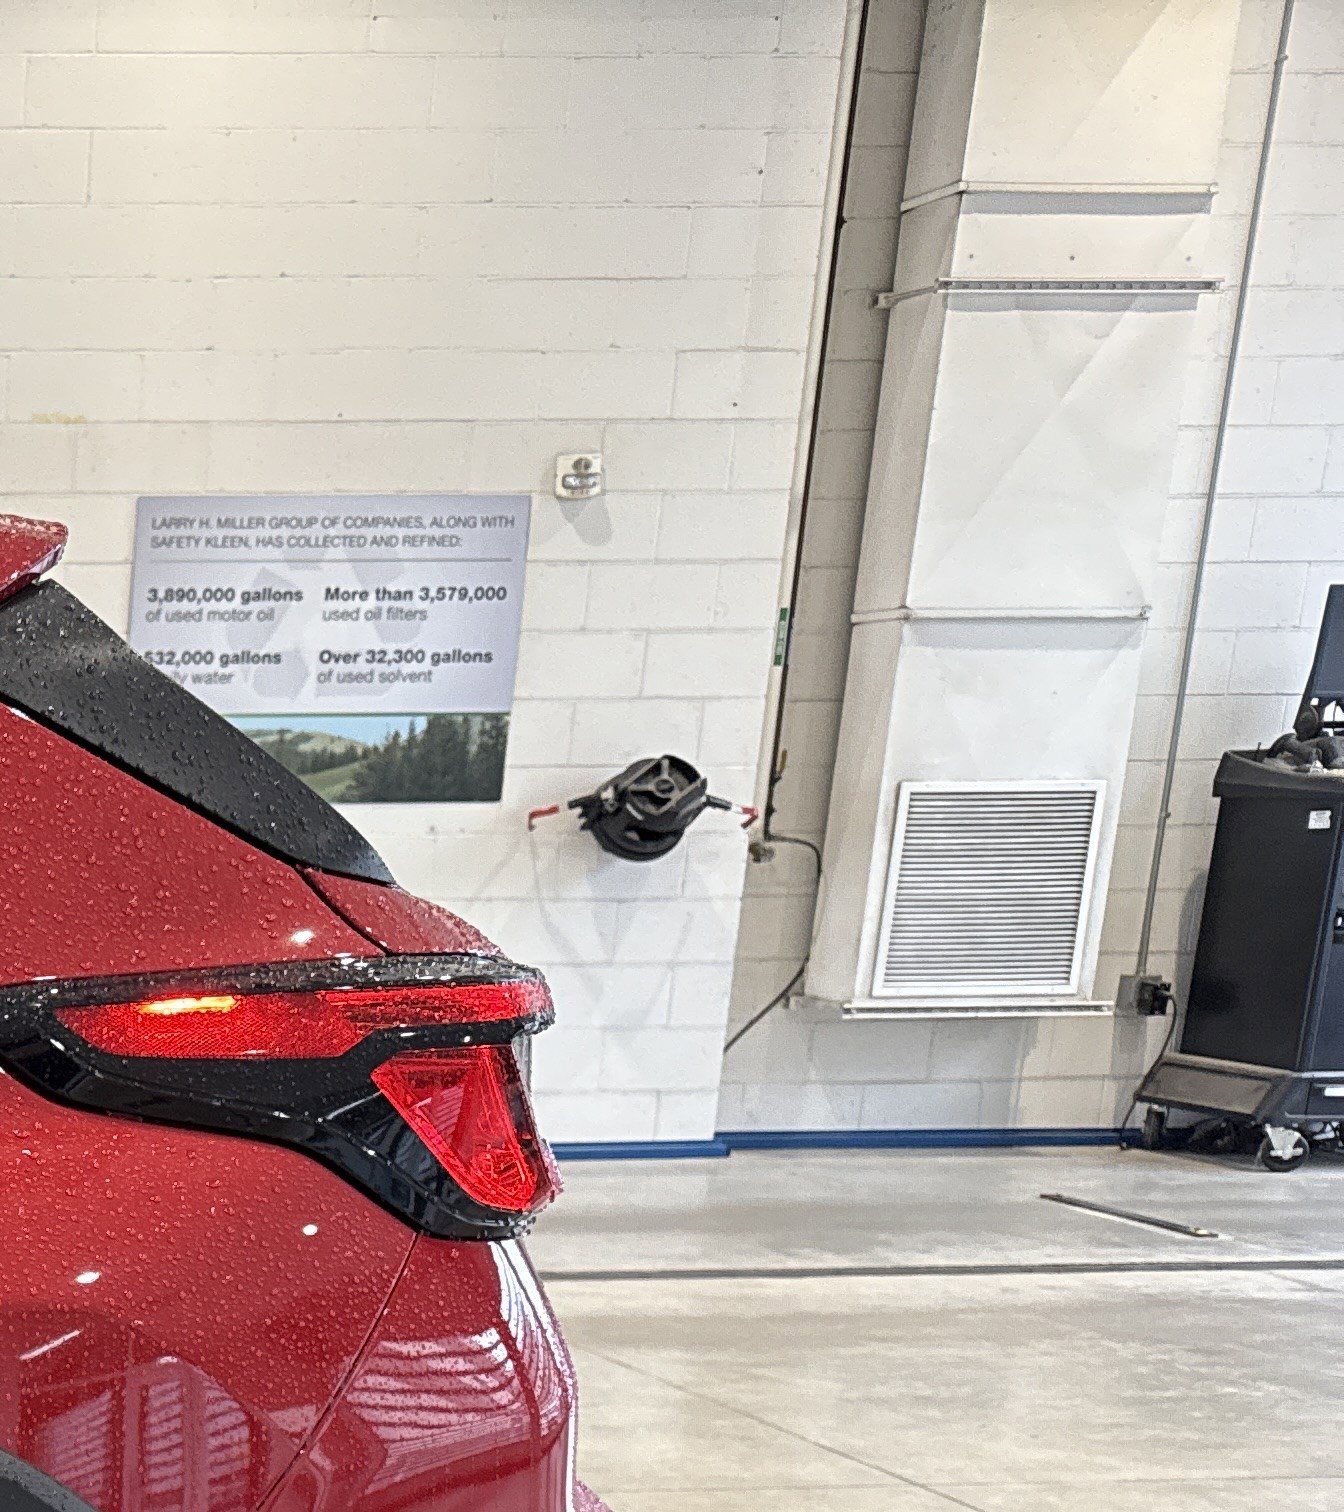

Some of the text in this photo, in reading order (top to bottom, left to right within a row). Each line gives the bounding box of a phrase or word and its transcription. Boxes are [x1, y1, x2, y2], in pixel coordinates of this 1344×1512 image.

[151, 515, 515, 531] LARRY H. MILLER GROUP OF COMPANIES, ALONG WITH
[150, 534, 202, 549] SAFETY
[255, 534, 284, 549] HAS
[286, 534, 367, 549] COLLECTED
[369, 534, 399, 548] AND
[401, 534, 463, 549] REFINED:
[147, 587, 304, 606] 3,890,000 gallons
[324, 586, 508, 605] More than 3,579,000
[144, 607, 276, 623] of used motor oil
[322, 606, 428, 622] used oil filters
[219, 650, 282, 668] gallons
[318, 649, 494, 667] Over 32,300 gallons
[190, 671, 235, 685] water
[316, 669, 433, 684] of used solvent
